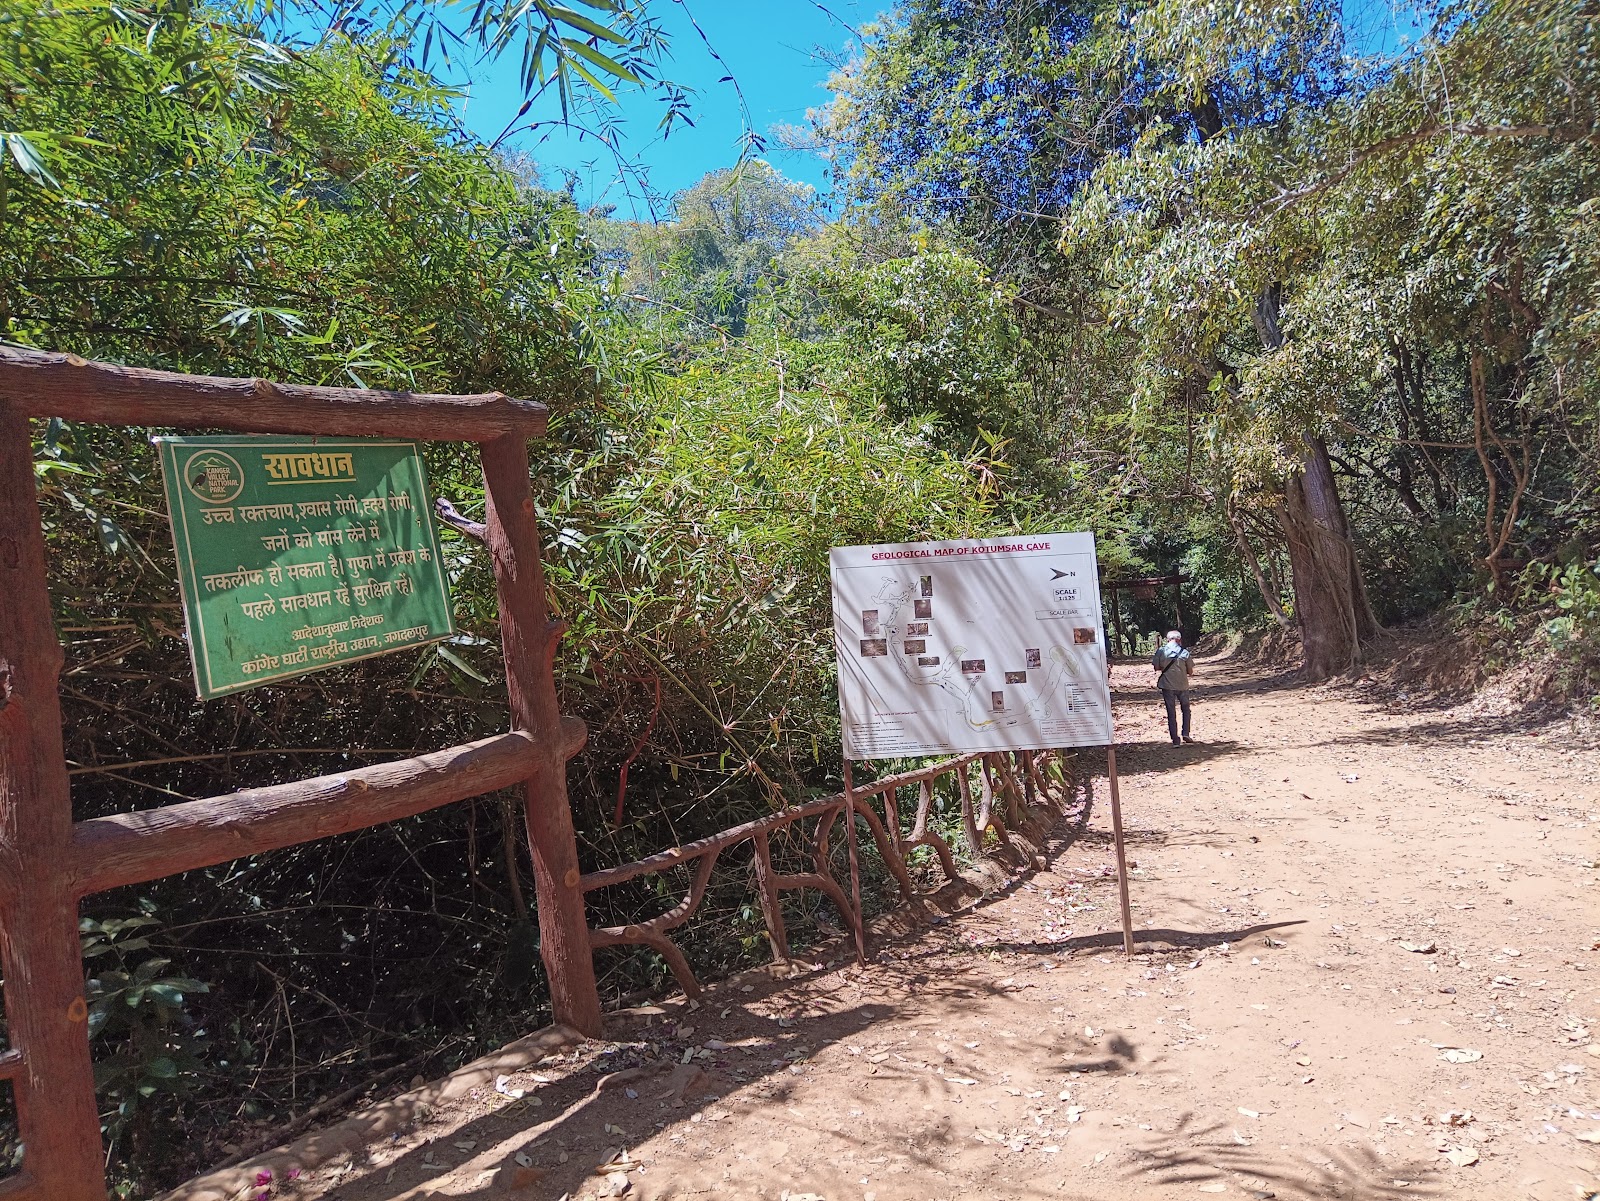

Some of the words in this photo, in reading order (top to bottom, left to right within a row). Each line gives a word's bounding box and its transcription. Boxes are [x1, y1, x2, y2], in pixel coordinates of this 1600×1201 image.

[261, 452, 354, 479] सावधान
[199, 507, 235, 525] उच्च
[388, 490, 416, 513] रोगी,
[260, 527, 290, 552] जनों
[292, 525, 313, 548] को
[315, 523, 344, 547] सांस
[345, 521, 367, 543] लेने
[368, 519, 380, 540] में
[871, 550, 931, 560] GEOLOGICAL
[934, 547, 954, 556] MAP
[956, 547, 969, 555] OF
[971, 543, 1024, 554] KOTUMSAR
[1026, 542, 1051, 552] CAVE
[201, 564, 264, 592] तकलीफ
[266, 560, 282, 587] हो
[284, 560, 326, 582] सकता
[345, 555, 374, 578] गुफा
[374, 547, 387, 568] में
[387, 545, 417, 567] प्रवेश
[417, 542, 431, 562] के
[240, 592, 276, 621] पहले
[278, 590, 332, 614] सावधान
[333, 581, 351, 606] रहें
[351, 577, 393, 607] सुरक्षित
[291, 620, 350, 641] आदेशानुसार
[349, 614, 384, 630] निदेशक
[241, 653, 280, 674] कांगेर
[281, 645, 309, 665] घाटी
[310, 638, 349, 660] राष्ट्रीय
[382, 624, 429, 643] जगदलपुर
